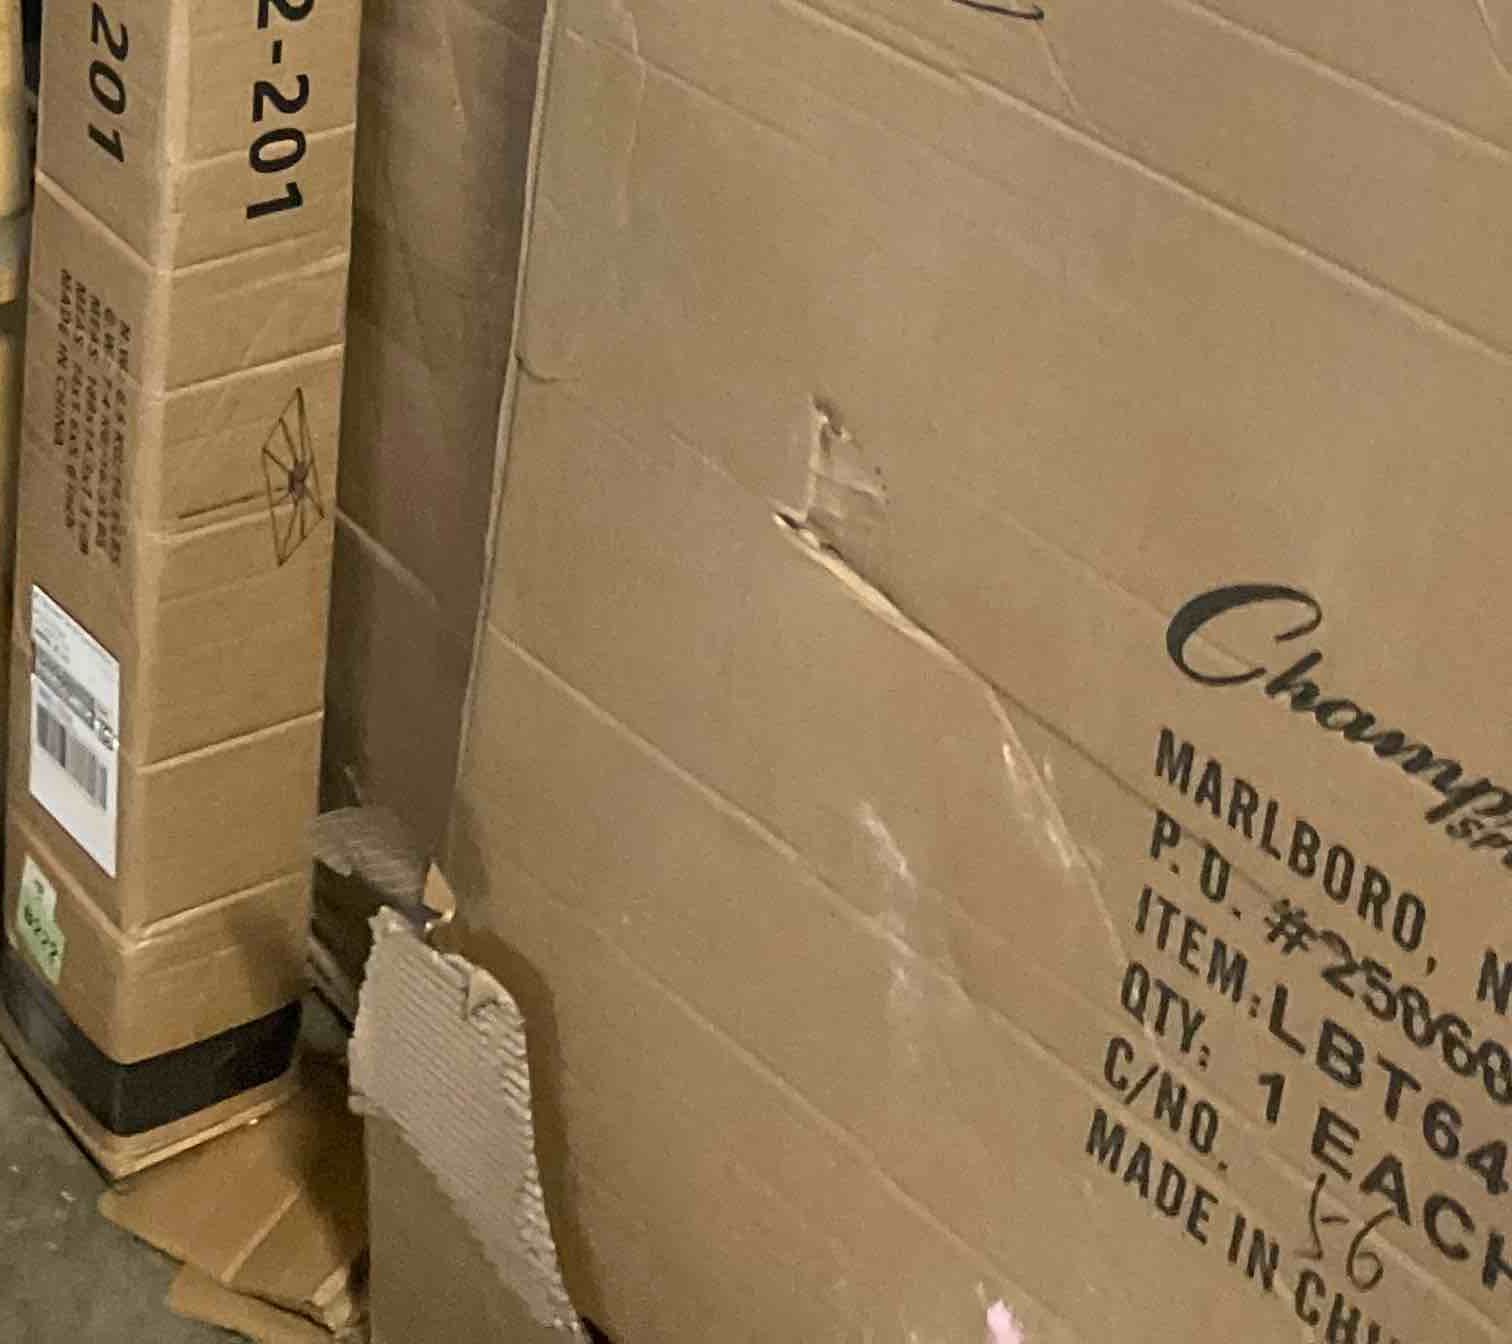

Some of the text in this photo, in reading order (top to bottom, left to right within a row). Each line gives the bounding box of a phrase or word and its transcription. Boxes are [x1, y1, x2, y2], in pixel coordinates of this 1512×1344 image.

[1154, 726, 1439, 977] MARLBORO,
[1103, 1036, 1229, 1175] C/NO.
[1118, 960, 1212, 1069] QTY:
[1257, 1071, 1286, 1125] 1
[1085, 1107, 1400, 1344] MADE IN CH
